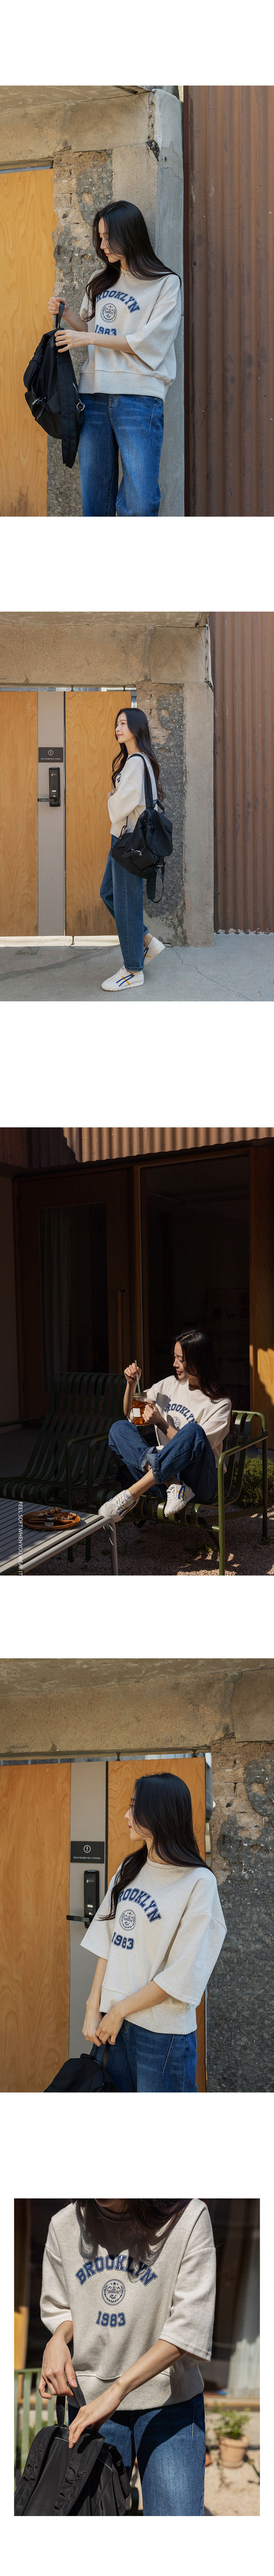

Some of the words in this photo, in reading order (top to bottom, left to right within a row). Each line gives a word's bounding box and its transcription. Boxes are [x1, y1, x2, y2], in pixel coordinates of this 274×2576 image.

[95, 290, 141, 314] ROOKLYN
[166, 1403, 198, 1424] ROOKLYN
[118, 1888, 162, 1923] ROOKLYN
[111, 1931, 134, 1950] 1983
[75, 2254, 158, 2287] BROOKLYN
[96, 2311, 126, 2327] 1983
